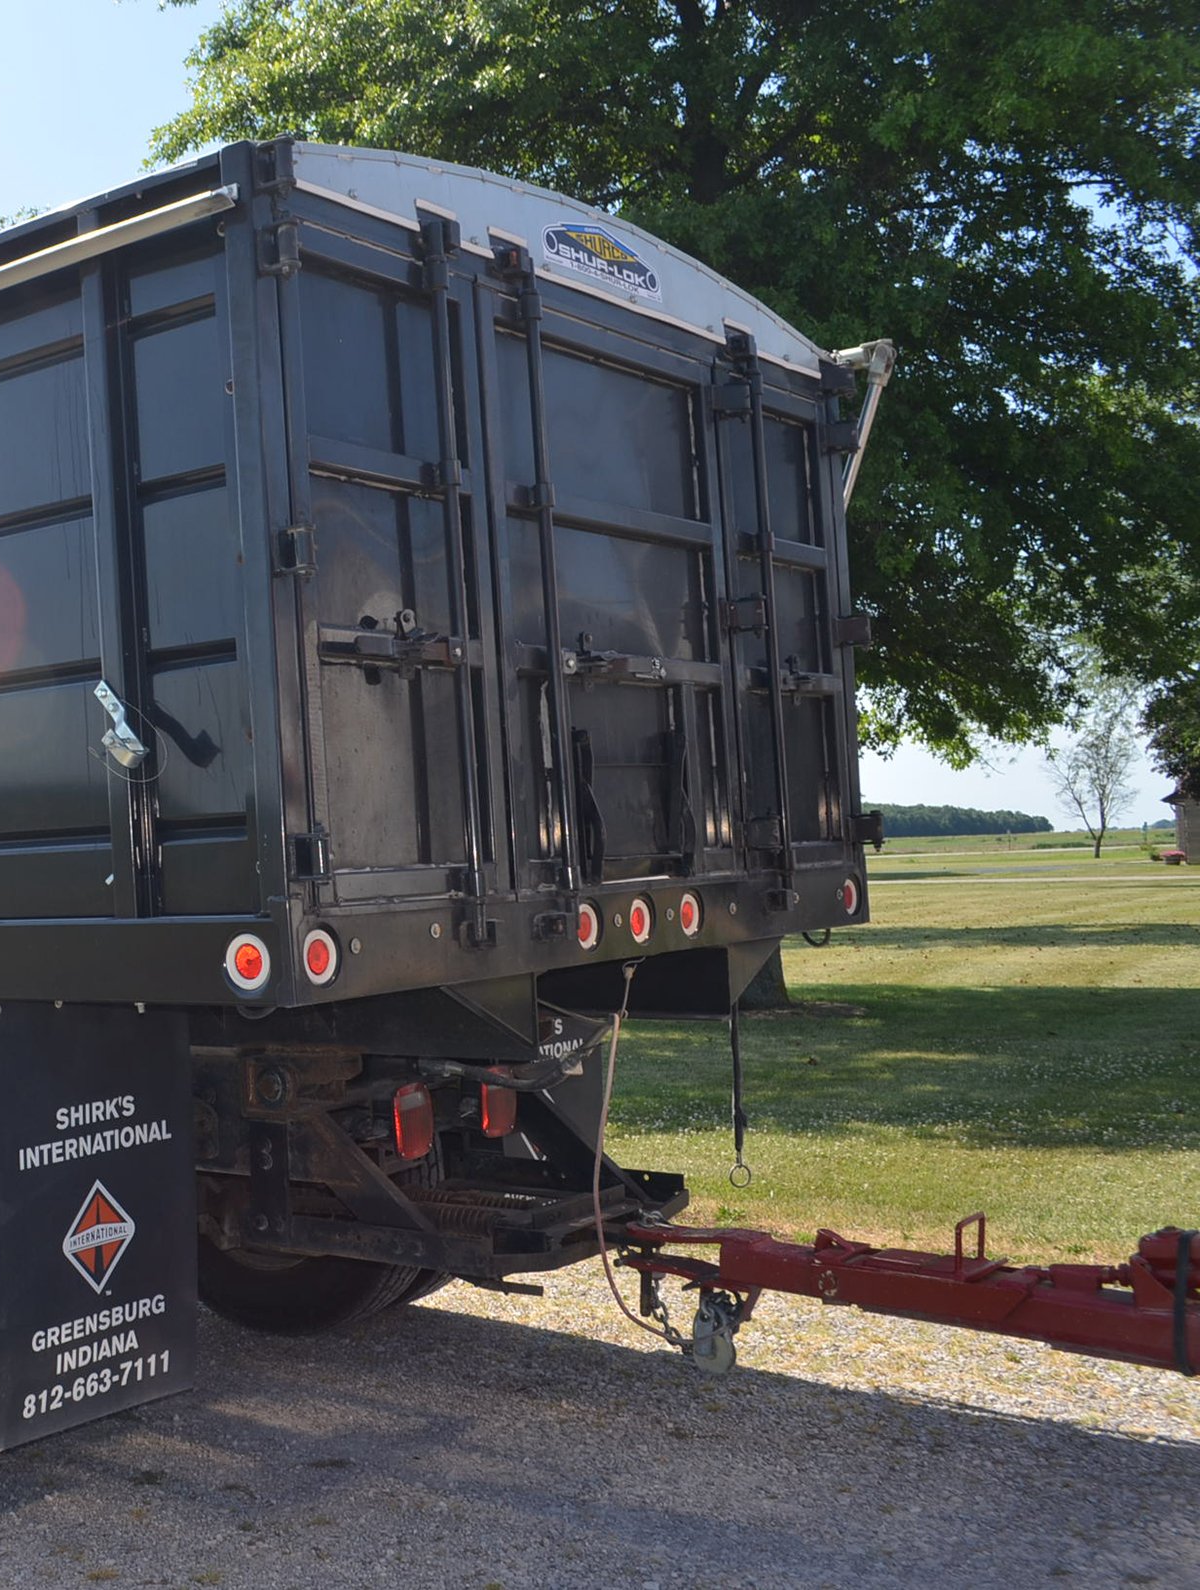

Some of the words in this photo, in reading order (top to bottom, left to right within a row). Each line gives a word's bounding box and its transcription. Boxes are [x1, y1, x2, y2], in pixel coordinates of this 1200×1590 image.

[558, 243, 646, 288] SHUR-LOK
[56, 1095, 135, 1130] SHIRK'S
[18, 1119, 172, 1171] INTERNATIONAL
[69, 1226, 128, 1248] INTERNATIONAL
[31, 1294, 166, 1352] GREENSBURG
[56, 1330, 139, 1375] INDIANA
[22, 1350, 170, 1419] 812-663-7111
